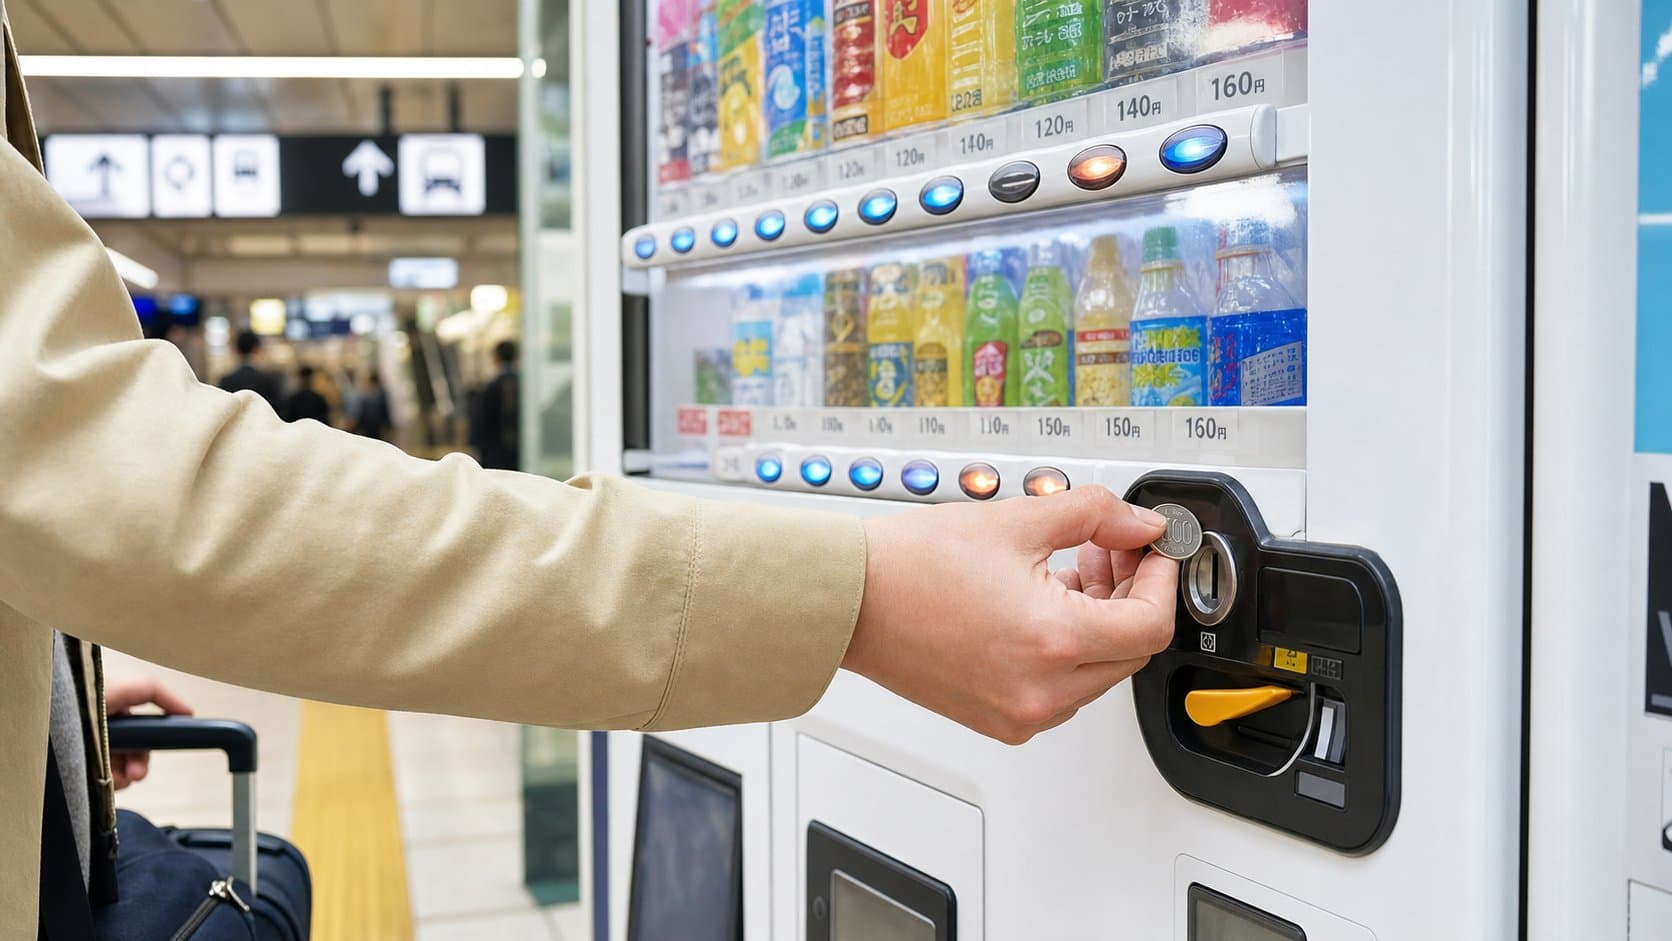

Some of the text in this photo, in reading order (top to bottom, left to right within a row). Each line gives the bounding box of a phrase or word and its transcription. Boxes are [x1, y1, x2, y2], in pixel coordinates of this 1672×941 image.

[1212, 71, 1265, 100] 160円
[1117, 95, 1161, 121] 140円
[1035, 115, 1074, 138] 120円
[960, 133, 993, 154] 140円
[980, 416, 1009, 435] 110円
[1038, 417, 1071, 437] 150円
[1106, 417, 1140, 438] 150円
[1186, 417, 1227, 440] 160円
